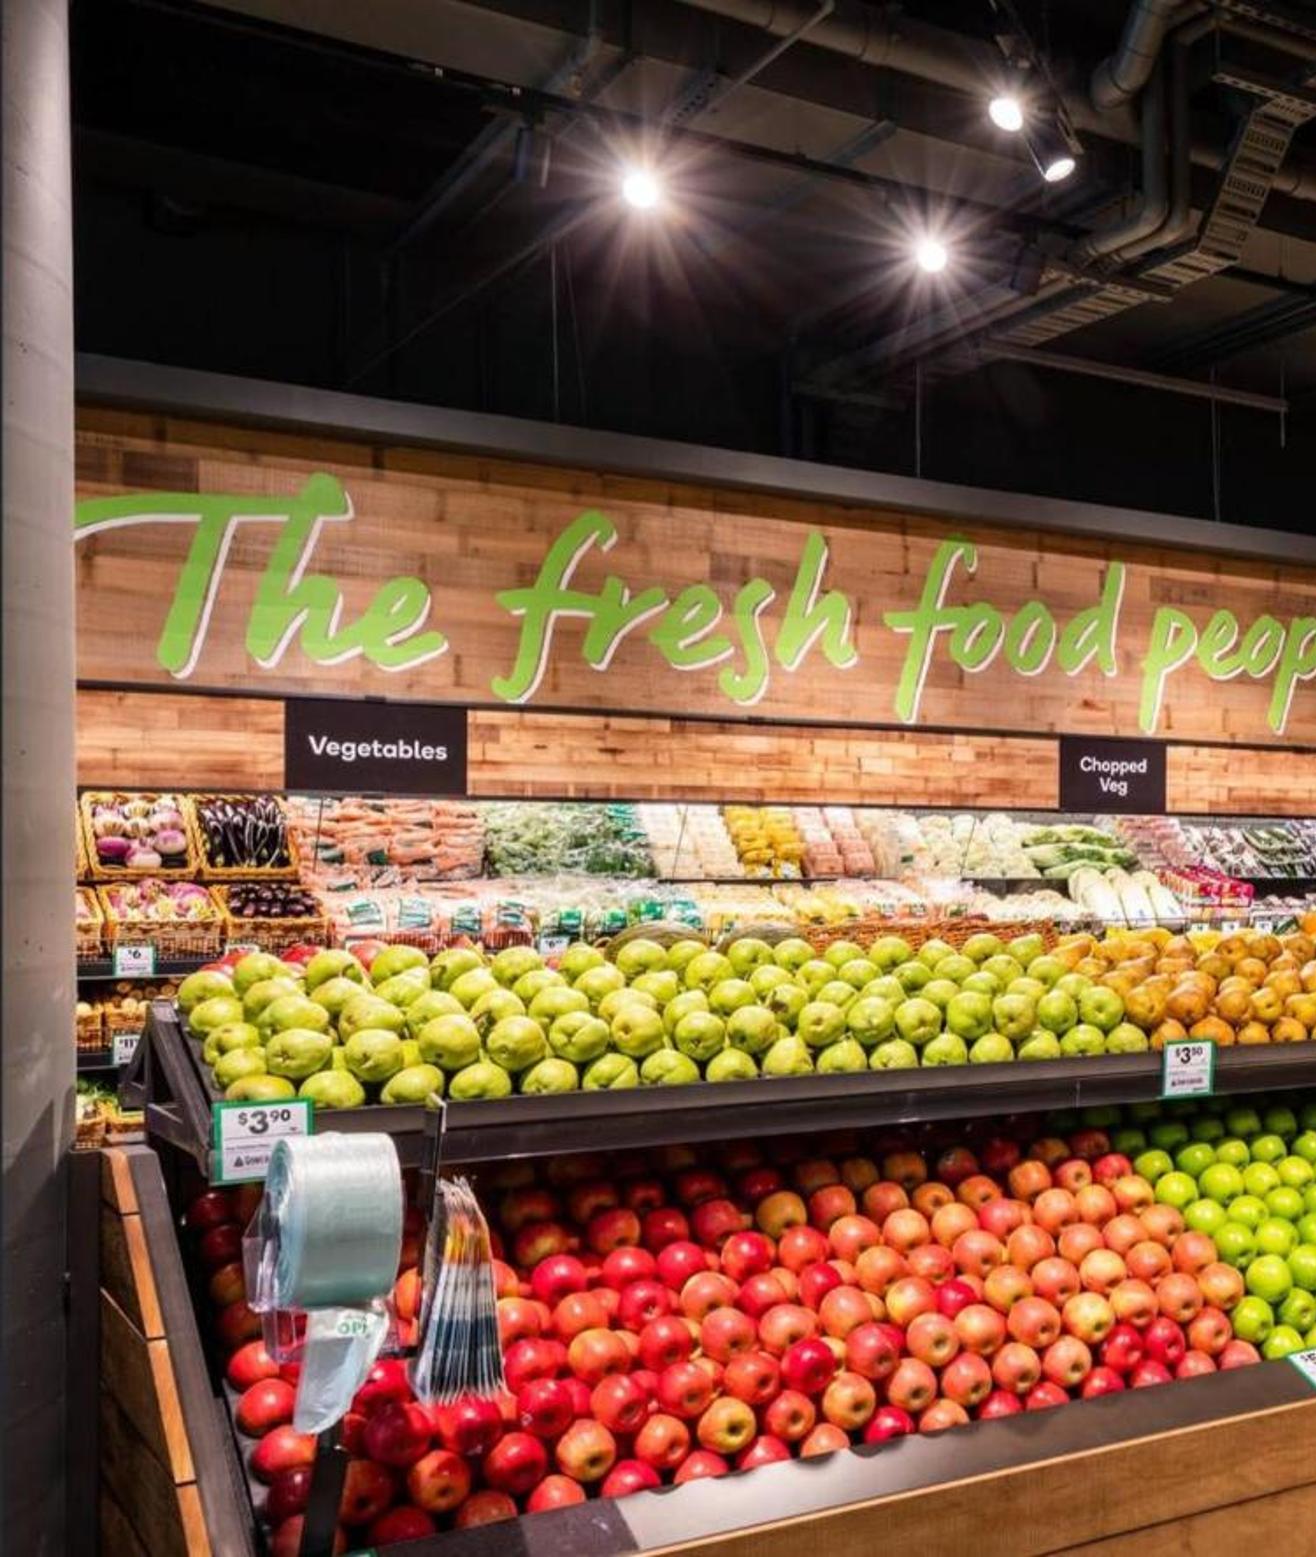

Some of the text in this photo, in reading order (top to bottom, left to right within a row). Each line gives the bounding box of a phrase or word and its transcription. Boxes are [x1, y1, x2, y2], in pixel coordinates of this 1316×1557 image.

[74, 472, 449, 680] The
[492, 509, 860, 706] fresh
[884, 533, 1127, 724] food
[308, 734, 448, 764] Vegetables
[1079, 755, 1148, 777] Chopped
[1099, 776, 1128, 797] Veg
